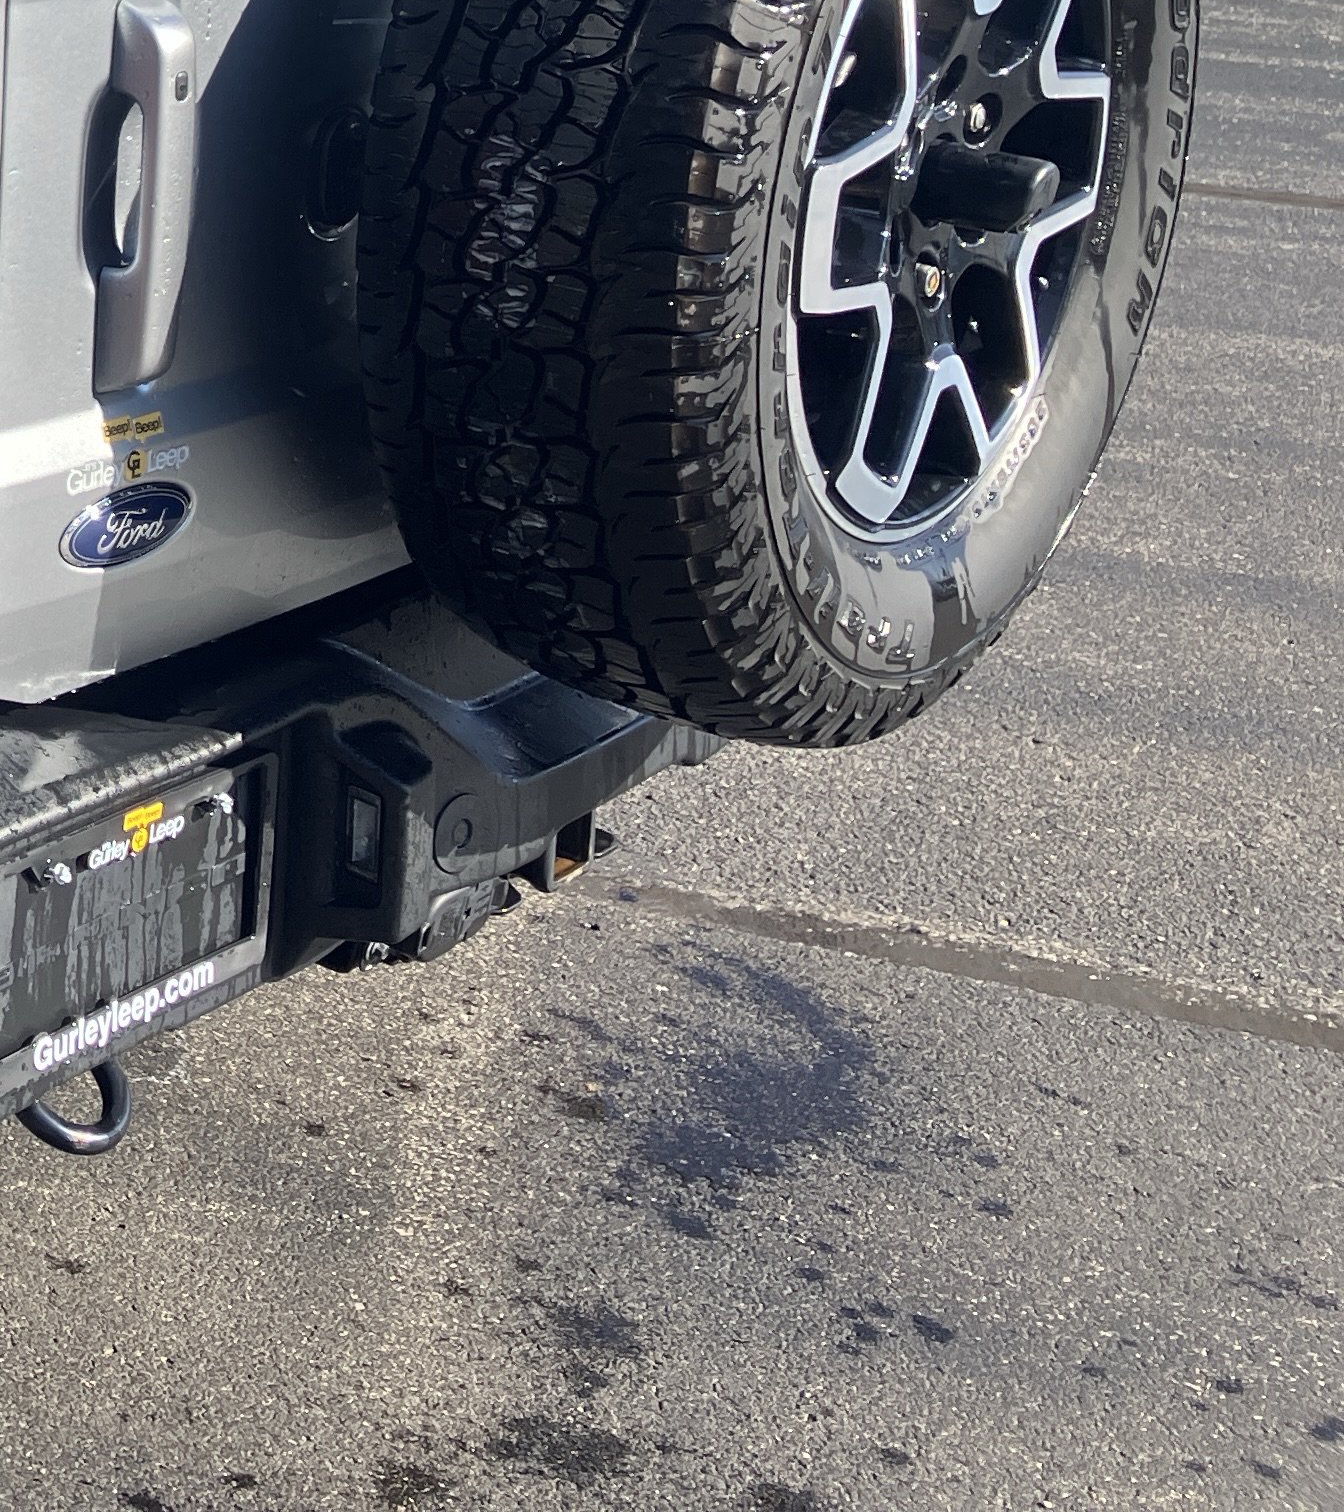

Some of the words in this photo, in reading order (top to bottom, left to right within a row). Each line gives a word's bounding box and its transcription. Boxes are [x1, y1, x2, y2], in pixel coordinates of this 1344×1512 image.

[134, 415, 163, 434] Beep!
[66, 460, 125, 497] Gurley
[146, 445, 190, 473] Leep
[96, 506, 169, 555] Ford
[149, 815, 185, 844] Leep
[33, 960, 215, 1072] Gurleyleep.com
